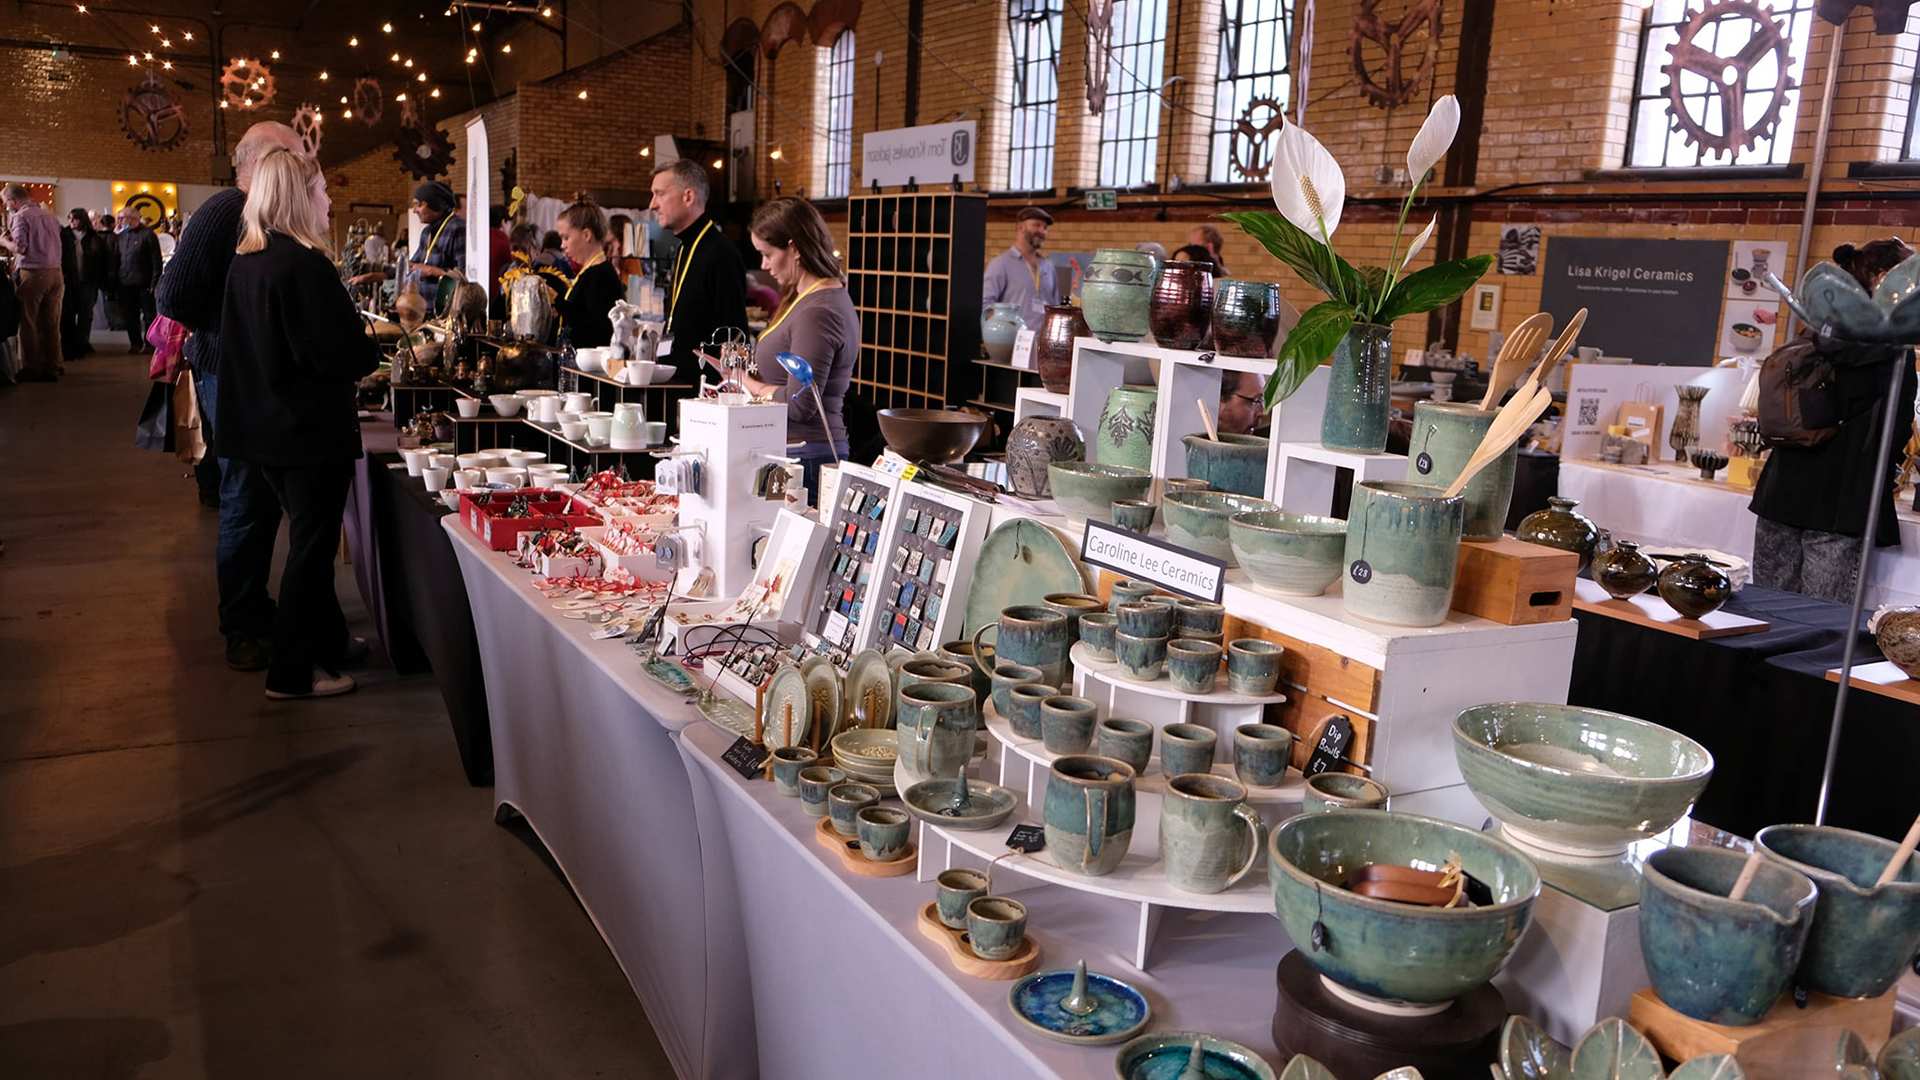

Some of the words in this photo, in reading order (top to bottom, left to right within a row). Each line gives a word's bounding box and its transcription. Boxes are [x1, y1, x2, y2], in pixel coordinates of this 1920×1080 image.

[1567, 265, 1592, 277] Lisa
[1594, 265, 1630, 281] Krigel
[1633, 267, 1694, 281] Ceramics
[1089, 535, 1138, 565] Caroline
[1140, 553, 1159, 572] Lee
[1161, 560, 1214, 591] Ceramics
[1328, 724, 1342, 744] Dip
[1319, 738, 1341, 759] Bowls
[1312, 758, 1327, 774] £7
